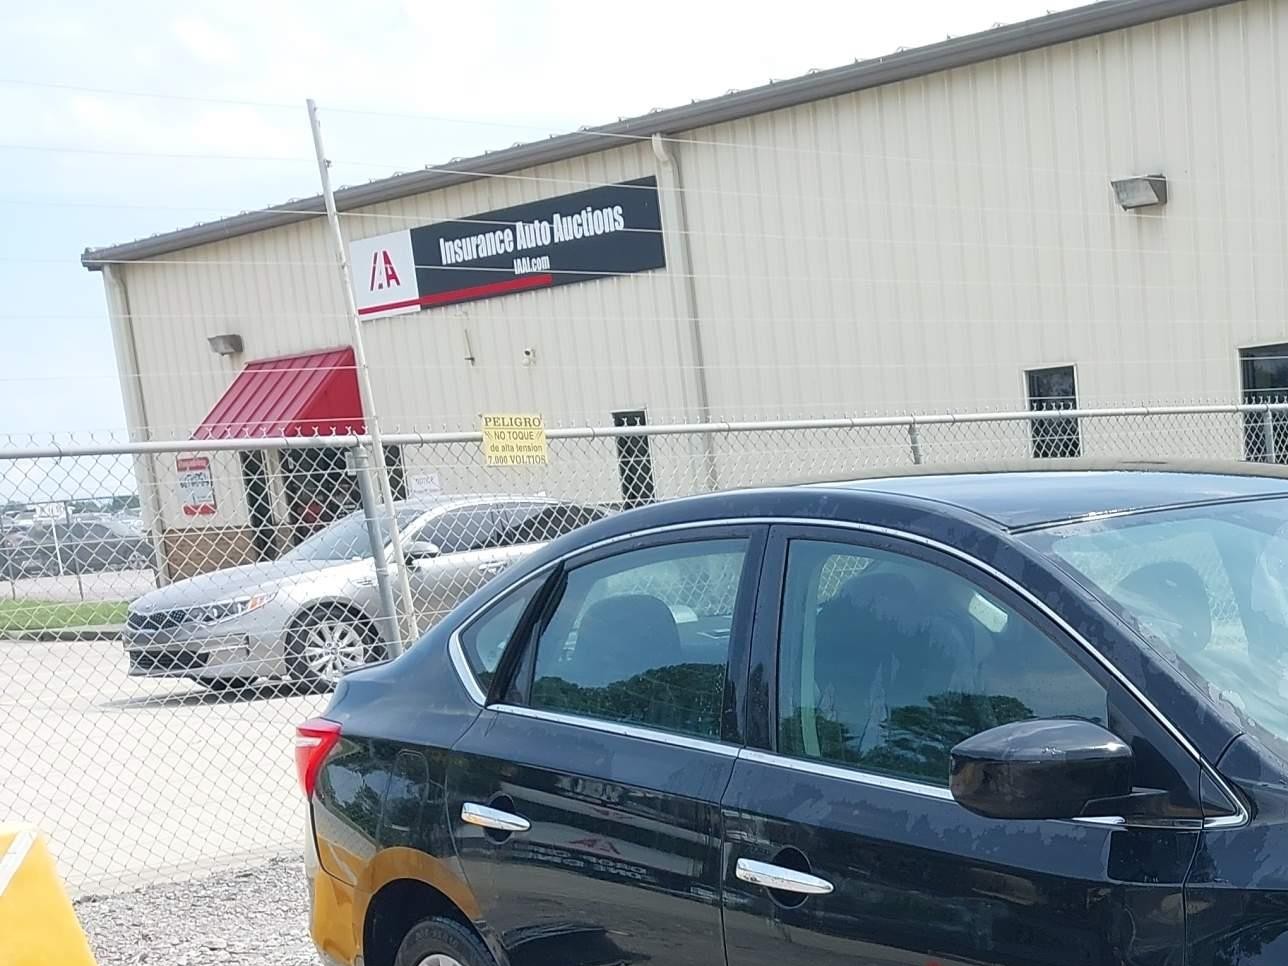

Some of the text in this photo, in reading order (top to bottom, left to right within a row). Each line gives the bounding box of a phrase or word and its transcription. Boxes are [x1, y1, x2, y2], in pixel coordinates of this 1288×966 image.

[440, 203, 625, 265] Insurance Auto Auctions
[513, 254, 551, 276] IAAI.com
[484, 416, 541, 427] PELIGRO
[494, 430, 535, 440] NO TOQUE
[490, 443, 543, 453] de alta tension
[510, 454, 547, 465] VOLTIOS
